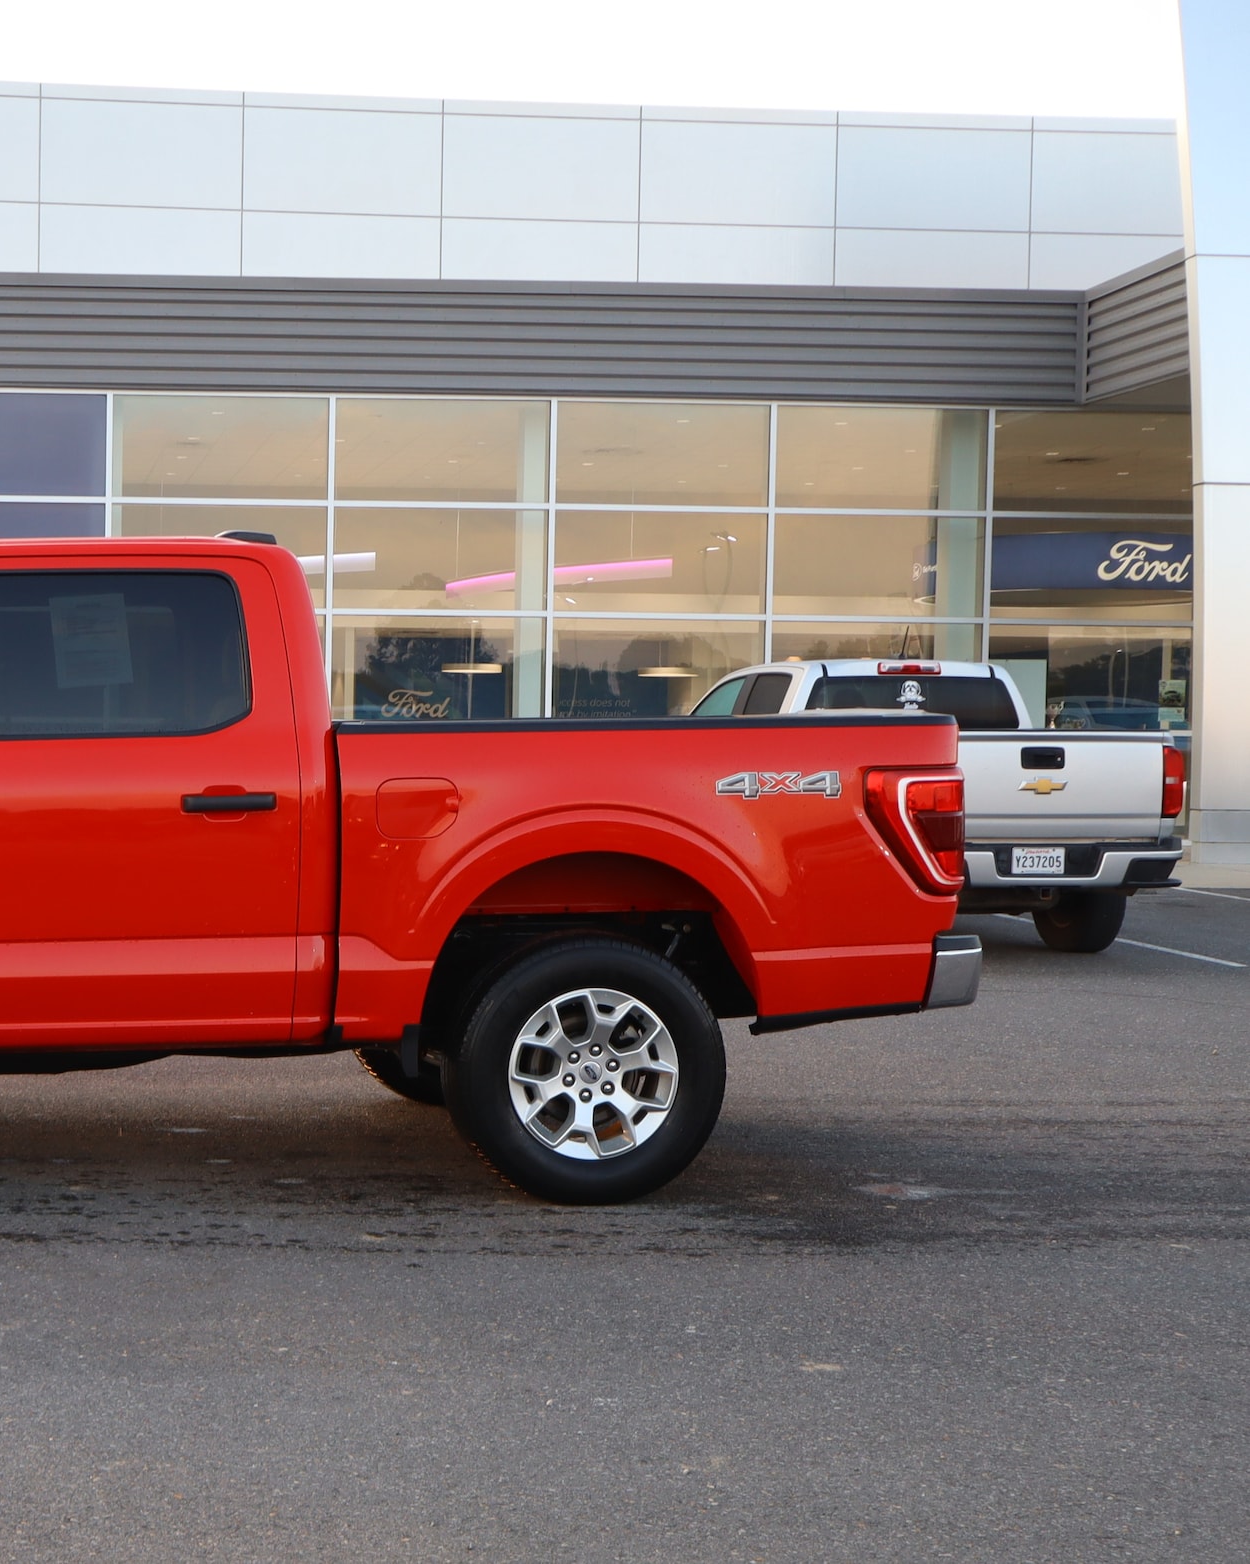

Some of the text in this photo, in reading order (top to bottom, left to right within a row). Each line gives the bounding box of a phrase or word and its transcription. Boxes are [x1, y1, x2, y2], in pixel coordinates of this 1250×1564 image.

[1097, 540, 1192, 583] Ford
[381, 689, 451, 718] Ford
[590, 697, 613, 707] does
[615, 698, 631, 707] not
[1015, 856, 1062, 868] Y237205
